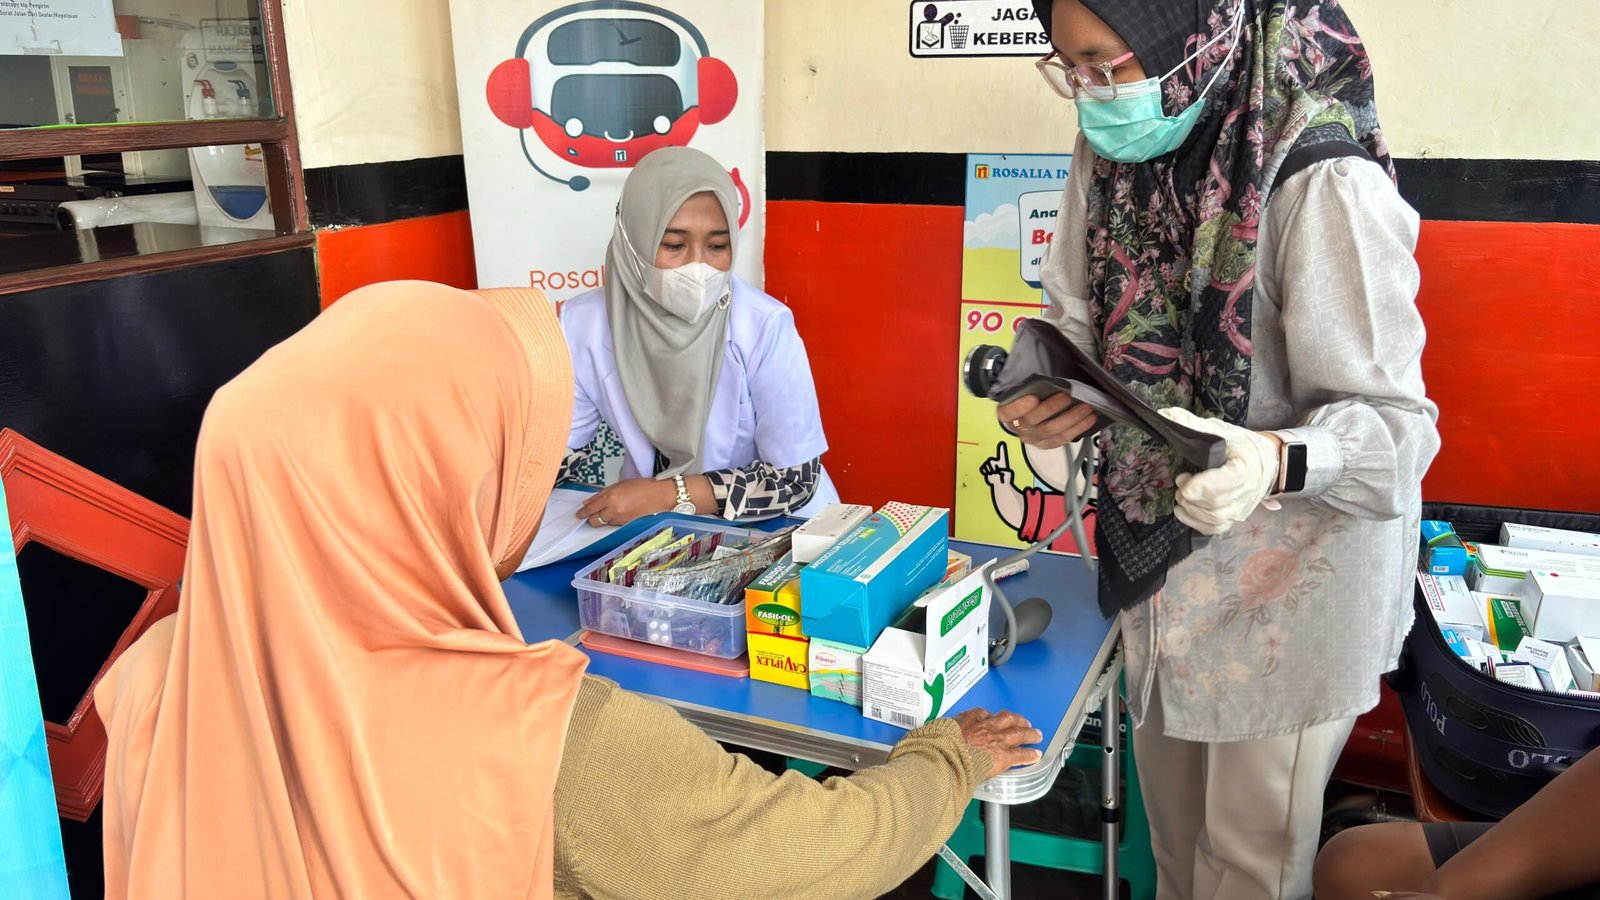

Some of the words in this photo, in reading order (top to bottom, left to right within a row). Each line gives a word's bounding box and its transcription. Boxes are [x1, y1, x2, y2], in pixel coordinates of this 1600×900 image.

[991, 8, 1038, 21] JAGA
[973, 32, 1050, 46] KEBERS
[992, 168, 1053, 179] ROSALIA
[1056, 169, 1070, 179] IN
[1029, 209, 1058, 220] Ana
[530, 265, 606, 290] Rosal
[967, 310, 1003, 332] 90
[756, 656, 807, 674] CAVIPLEX
[1420, 681, 1448, 736] POLO
